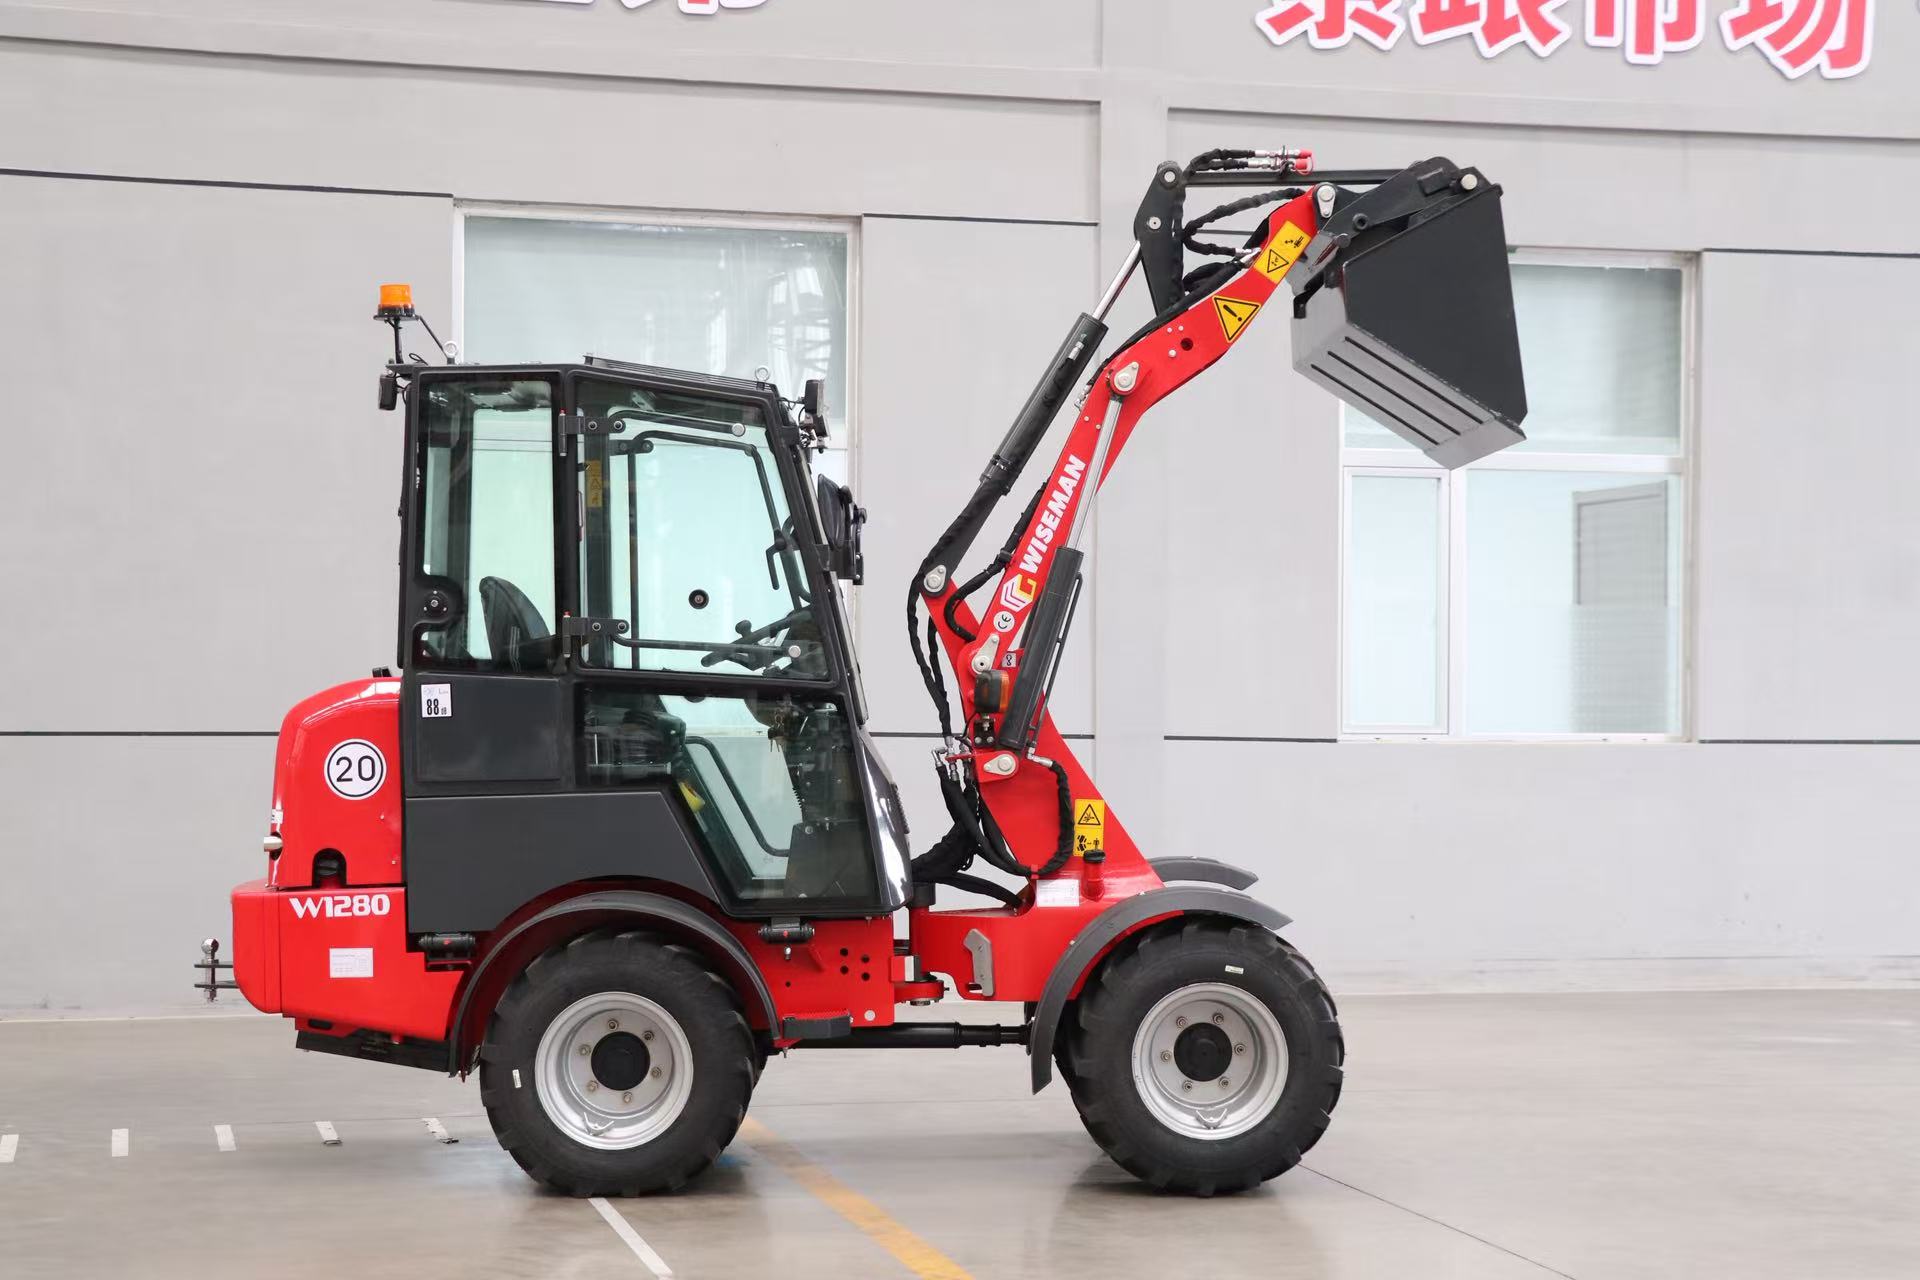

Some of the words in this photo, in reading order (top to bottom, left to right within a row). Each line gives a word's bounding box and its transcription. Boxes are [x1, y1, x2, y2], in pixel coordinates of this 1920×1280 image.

[1019, 454, 1086, 574] WISEMAN
[426, 698, 439, 715] 88
[336, 755, 376, 783] 20
[289, 894, 390, 919] W1280
